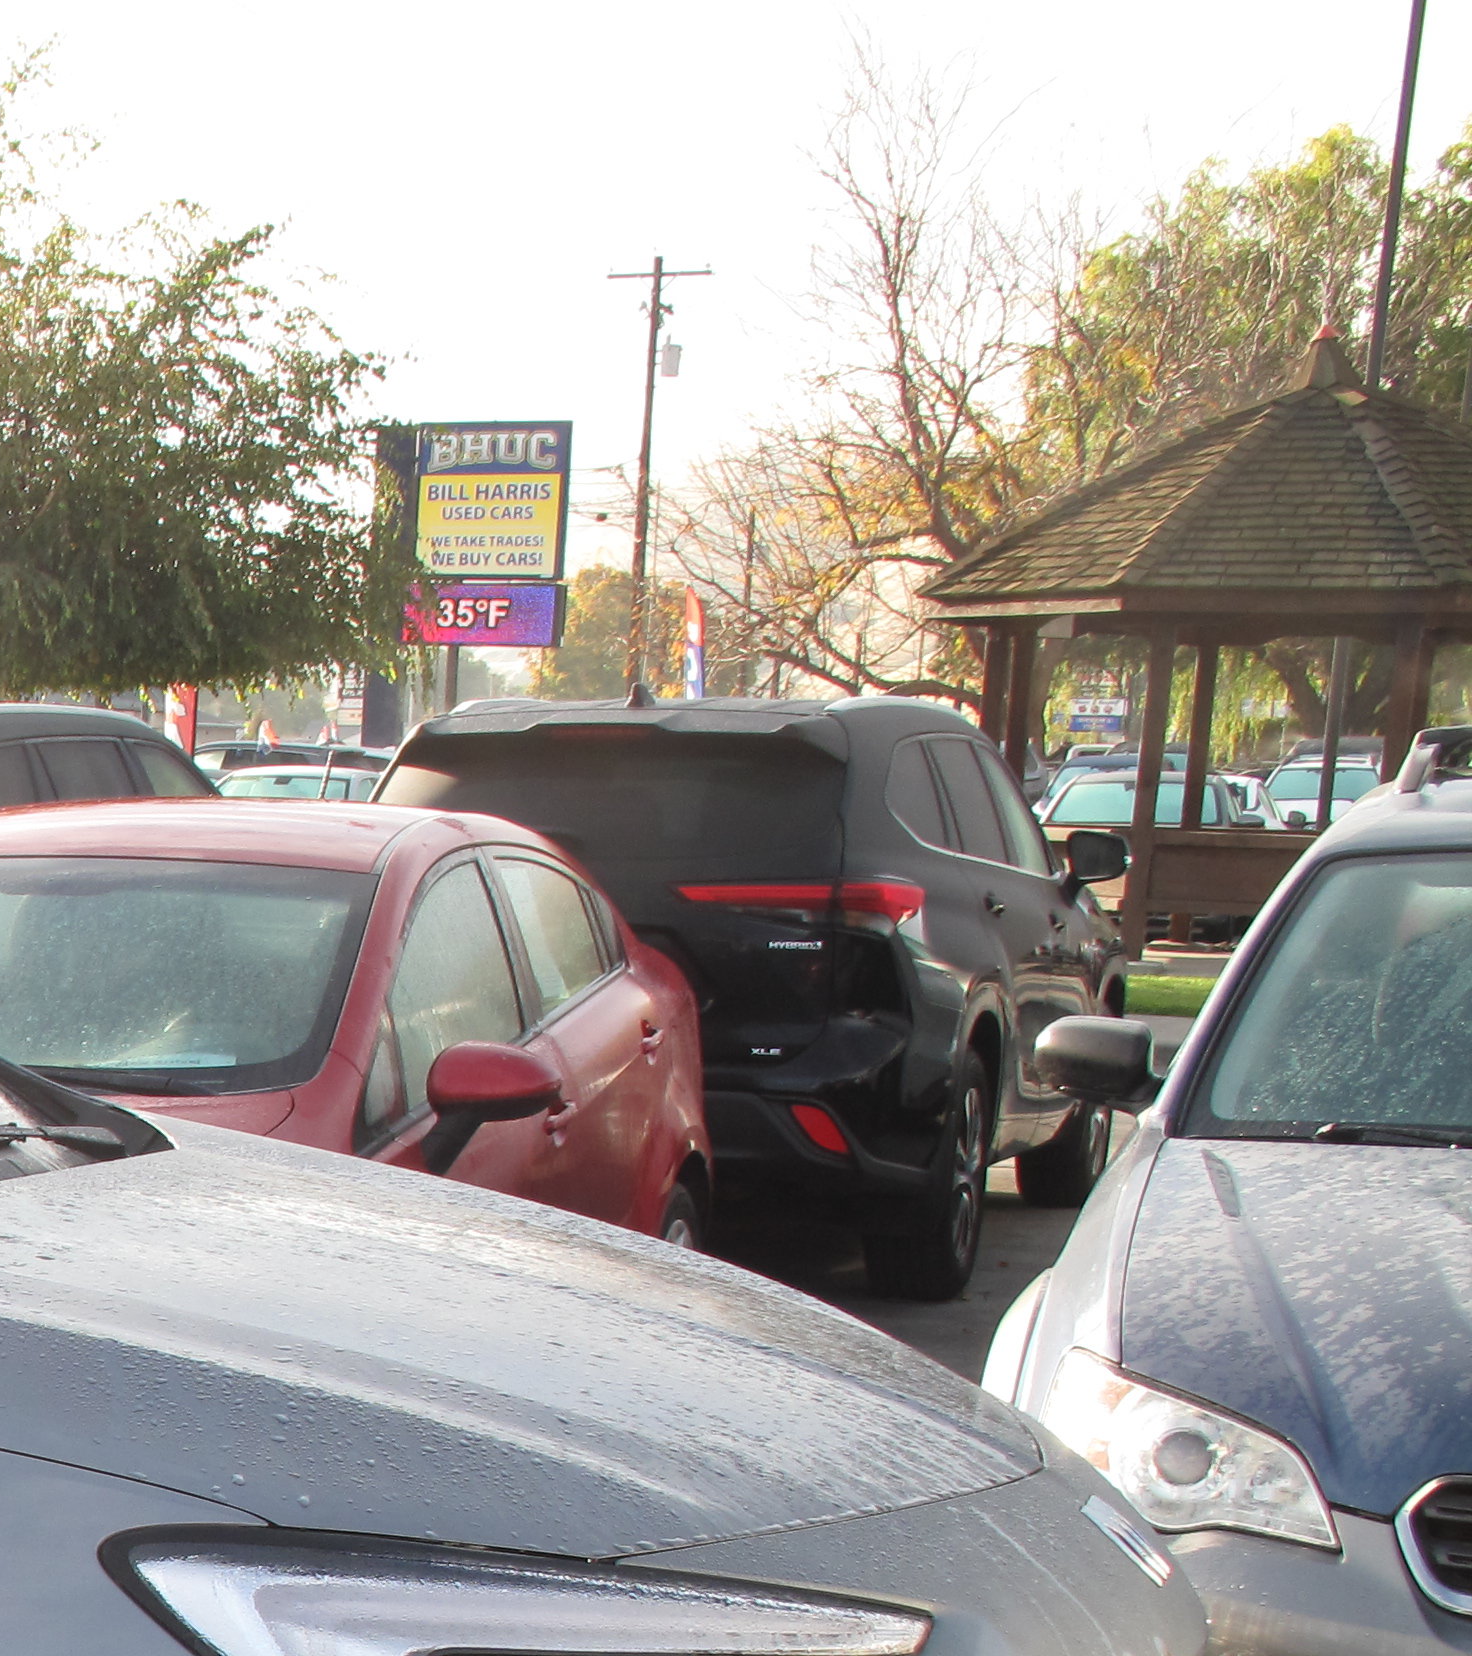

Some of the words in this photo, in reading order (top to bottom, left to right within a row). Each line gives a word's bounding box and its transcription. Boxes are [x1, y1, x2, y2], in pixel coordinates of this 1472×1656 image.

[427, 430, 557, 473] BHUC
[428, 484, 469, 501] BILL
[475, 483, 551, 501] HARRIS
[442, 506, 486, 520] USED
[490, 505, 534, 520] CARS
[430, 536, 451, 547] WE
[454, 536, 486, 547] TAKE
[489, 535, 544, 547] TRADES!
[430, 553, 455, 567] WE
[458, 553, 492, 567] BUY
[496, 552, 543, 566] CARS!
[436, 598, 512, 628] 35°F
[751, 1048, 781, 1056] XLE
